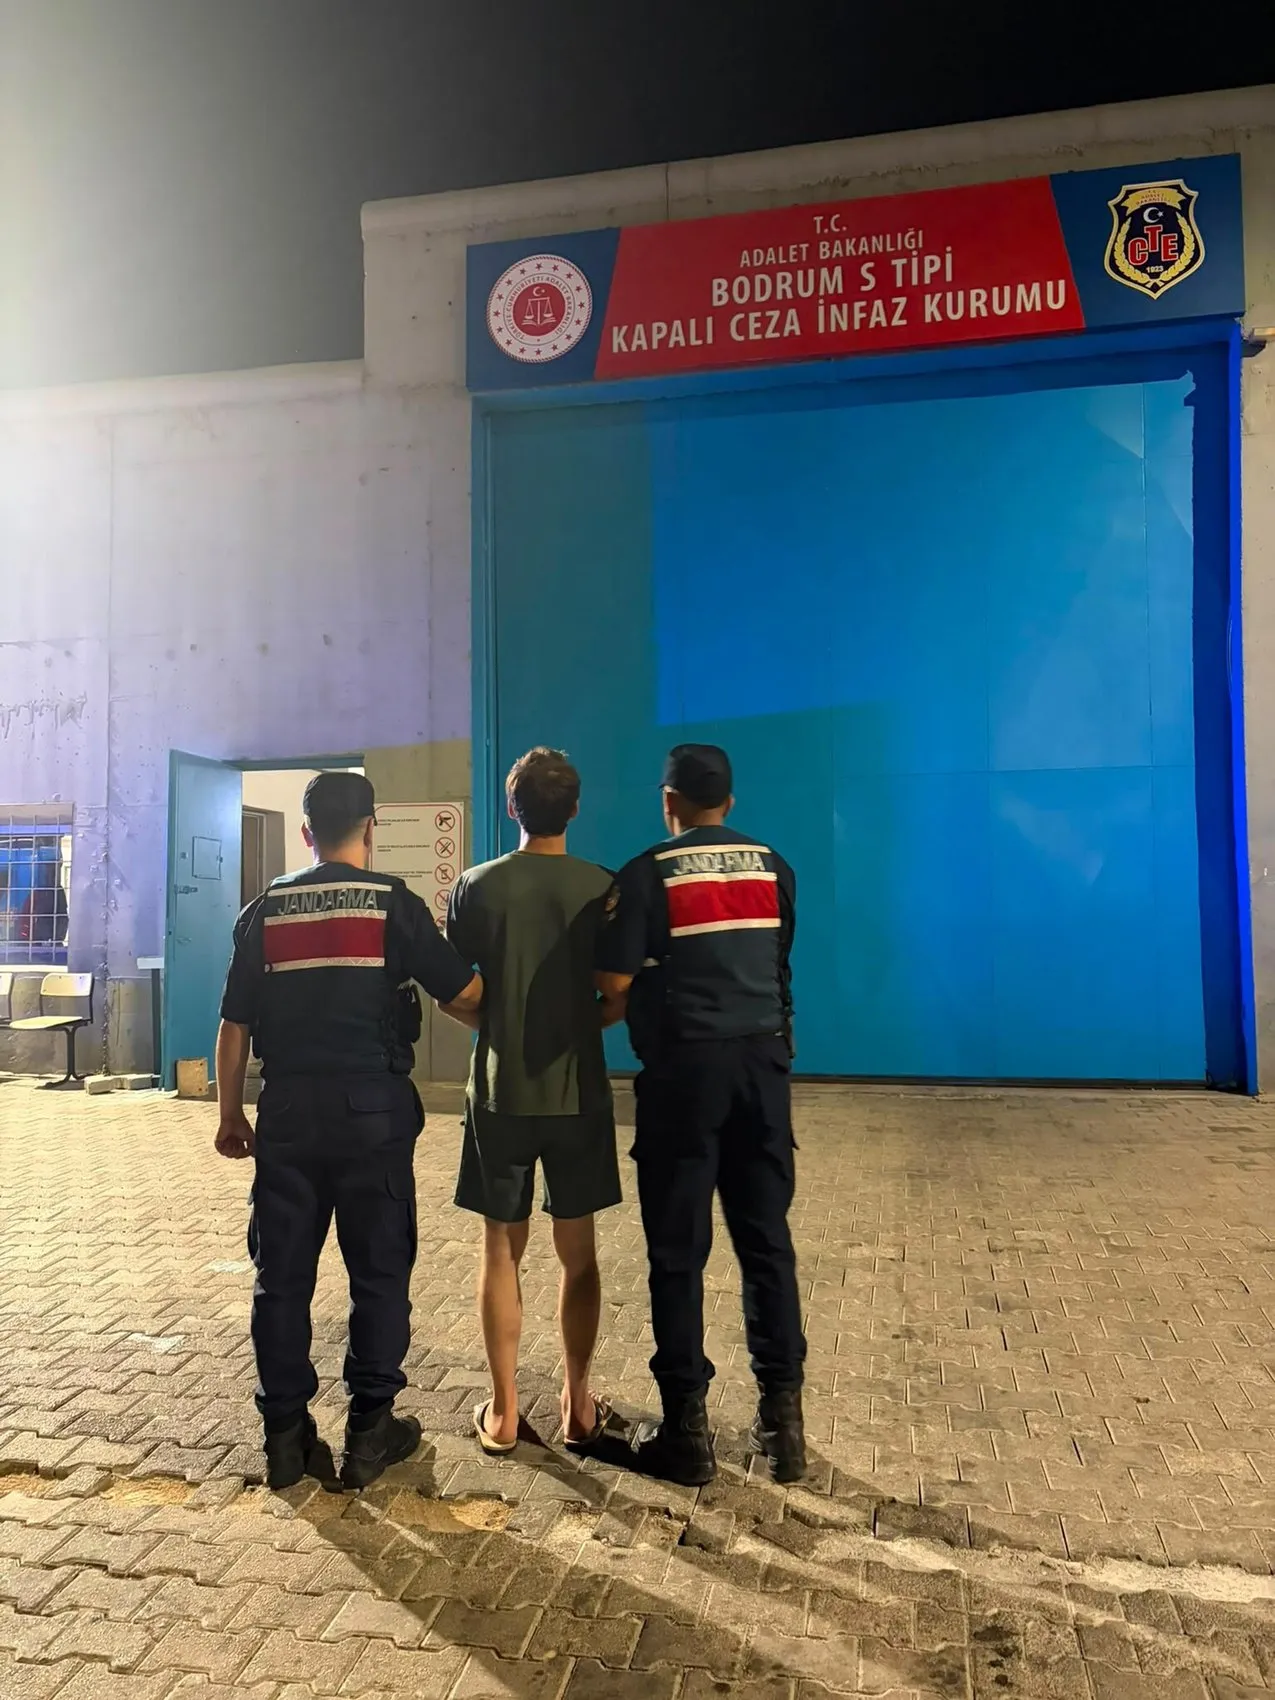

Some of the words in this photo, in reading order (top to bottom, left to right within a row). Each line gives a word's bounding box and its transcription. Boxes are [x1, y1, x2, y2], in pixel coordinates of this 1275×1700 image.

[814, 213, 847, 234] T.C.
[740, 243, 809, 268] ADALET
[819, 228, 923, 259] BAKANLIĞI
[1128, 224, 1178, 265] CTE
[712, 266, 843, 306] BODRUM
[860, 261, 876, 293] S
[892, 246, 952, 288] TİPİ
[612, 317, 713, 353] KAPALI
[730, 307, 801, 341] CEZA
[817, 284, 908, 333] İNFAZ
[924, 280, 1066, 322] KURUMU
[277, 889, 378, 915] JANDARMA
